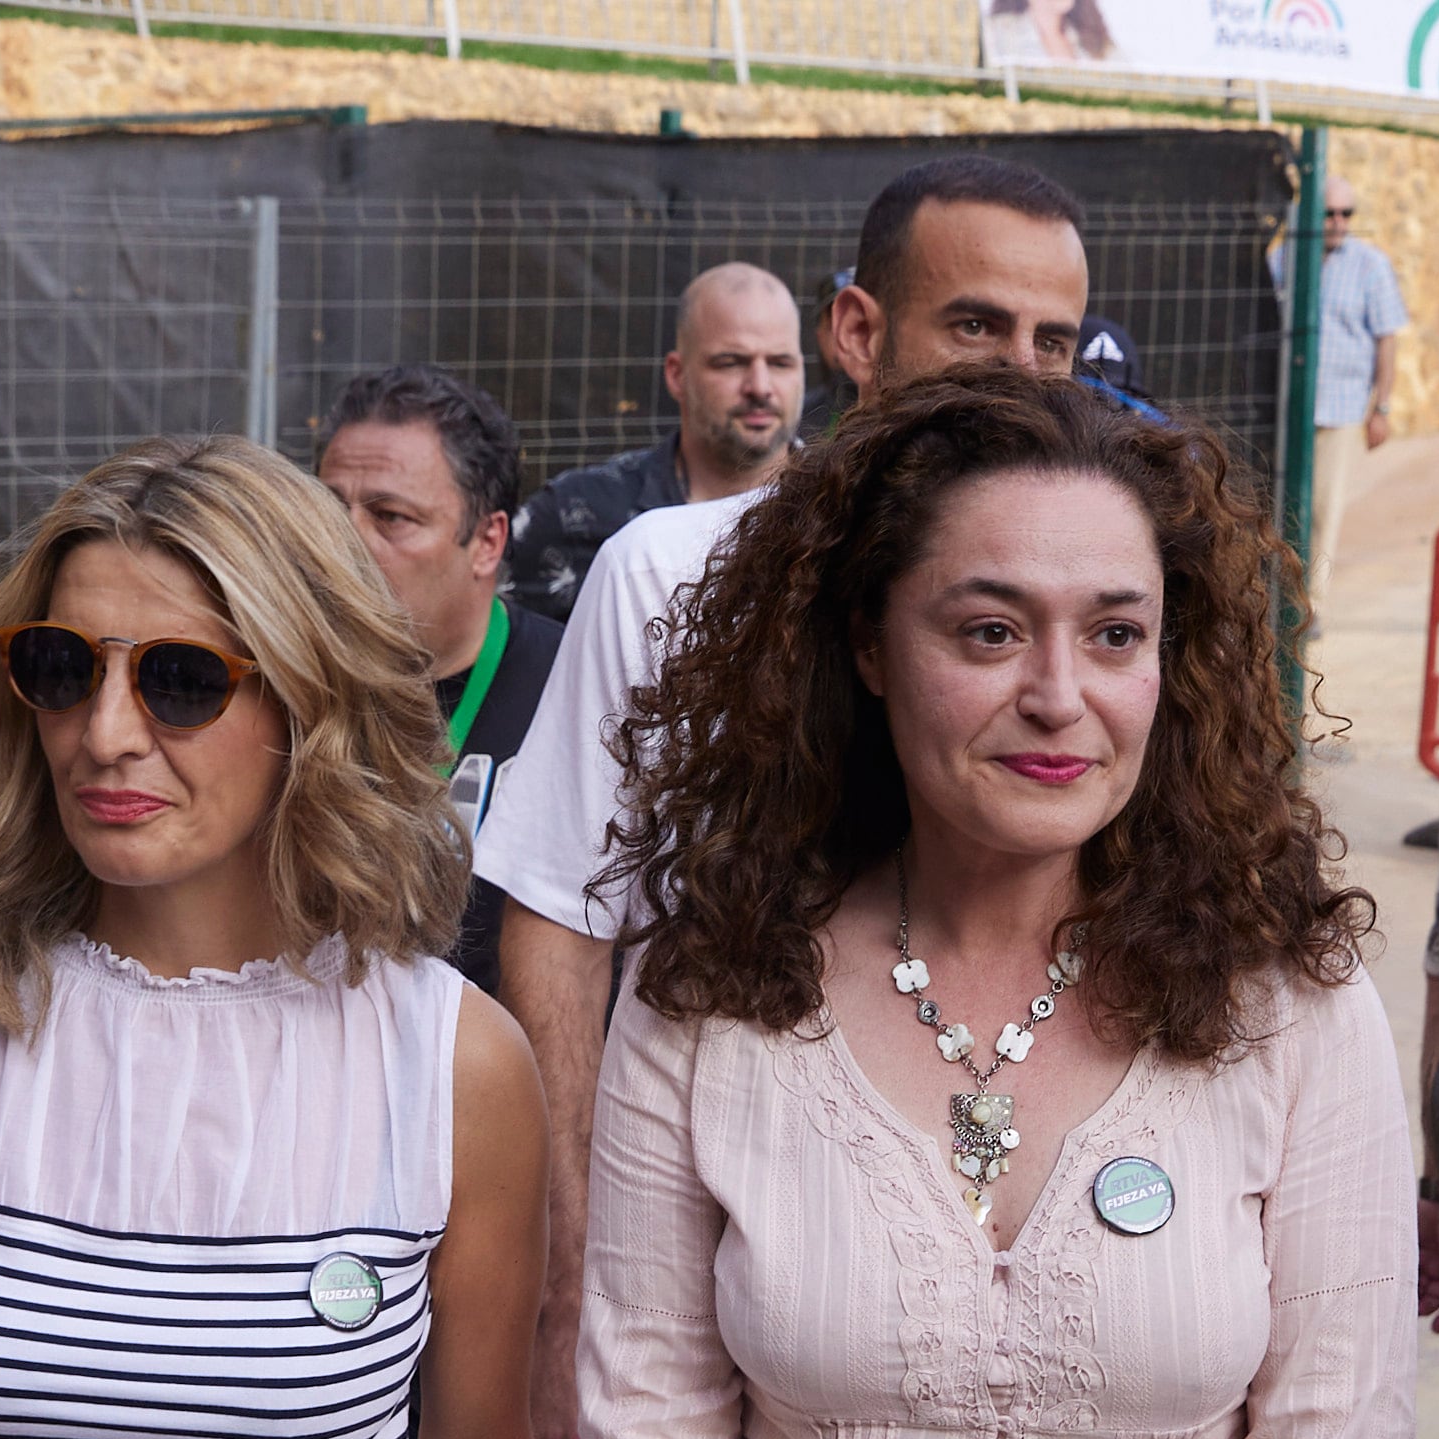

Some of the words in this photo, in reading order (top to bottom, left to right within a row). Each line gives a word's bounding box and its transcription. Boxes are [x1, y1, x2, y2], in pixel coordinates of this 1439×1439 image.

[1210, 0, 1255, 21] Por
[1110, 1170, 1151, 1192] RTVA
[1104, 1191, 1149, 1211] FIJEZA
[1149, 1181, 1167, 1195] YA
[317, 1288, 358, 1302] FIJEZA
[359, 1287, 377, 1298] YA
